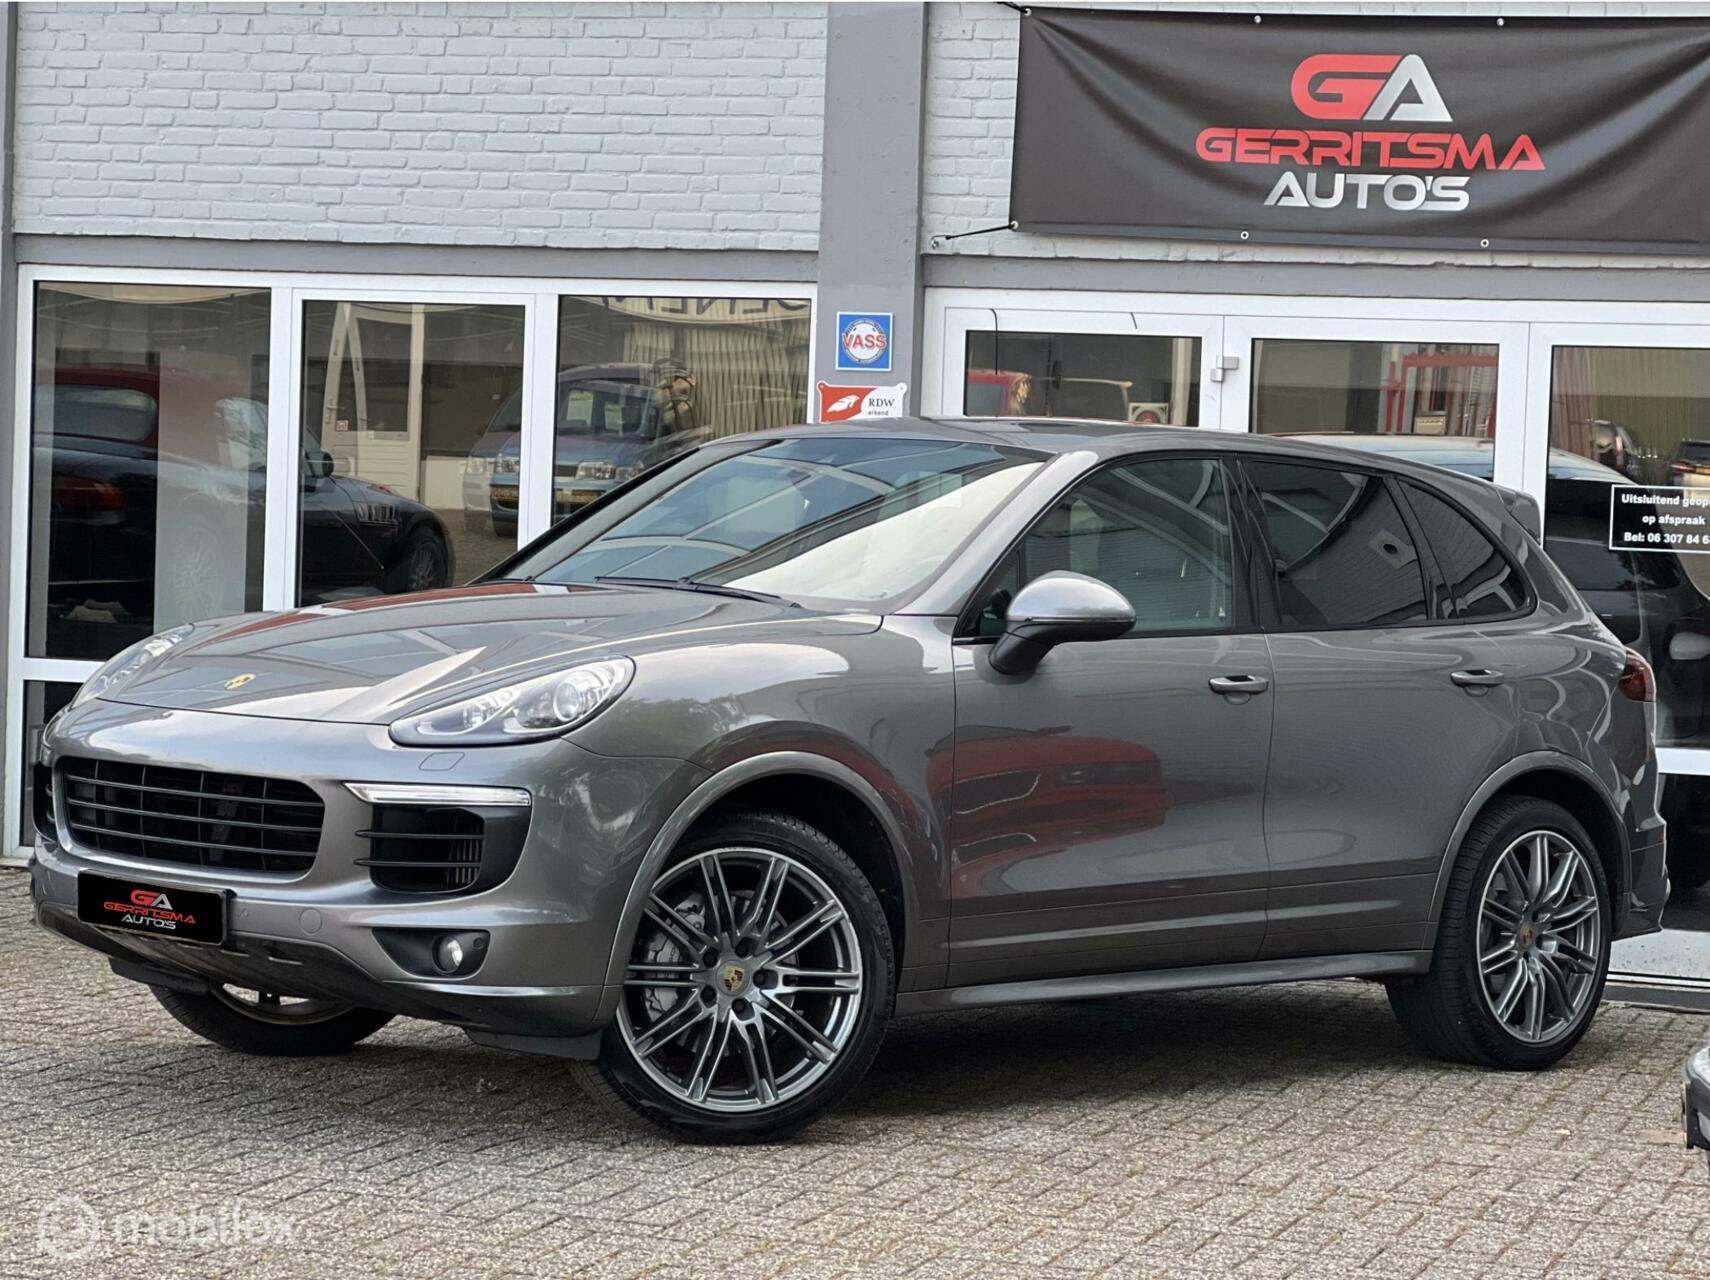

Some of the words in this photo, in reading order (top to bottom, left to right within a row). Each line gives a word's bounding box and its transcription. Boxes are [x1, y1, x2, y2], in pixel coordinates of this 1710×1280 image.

[1291, 54, 1453, 122] GA
[1195, 127, 1546, 170] GERRITSMA
[1263, 171, 1470, 212] AUTO'S
[843, 333, 887, 350] VASS
[868, 398, 895, 408] RDW
[1621, 494, 1680, 505] Uitsluitend
[1642, 515, 1656, 525] op
[1658, 514, 1706, 526] afspraak
[1624, 532, 1645, 542] Bel:
[1647, 533, 1661, 543] 06
[1663, 533, 1684, 543] 307
[1686, 534, 1700, 544] 84
[1702, 535, 1710, 545] 6
[130, 889, 173, 911] GA
[103, 901, 197, 925] GERRITSMA
[121, 913, 177, 930] AUTO'S
